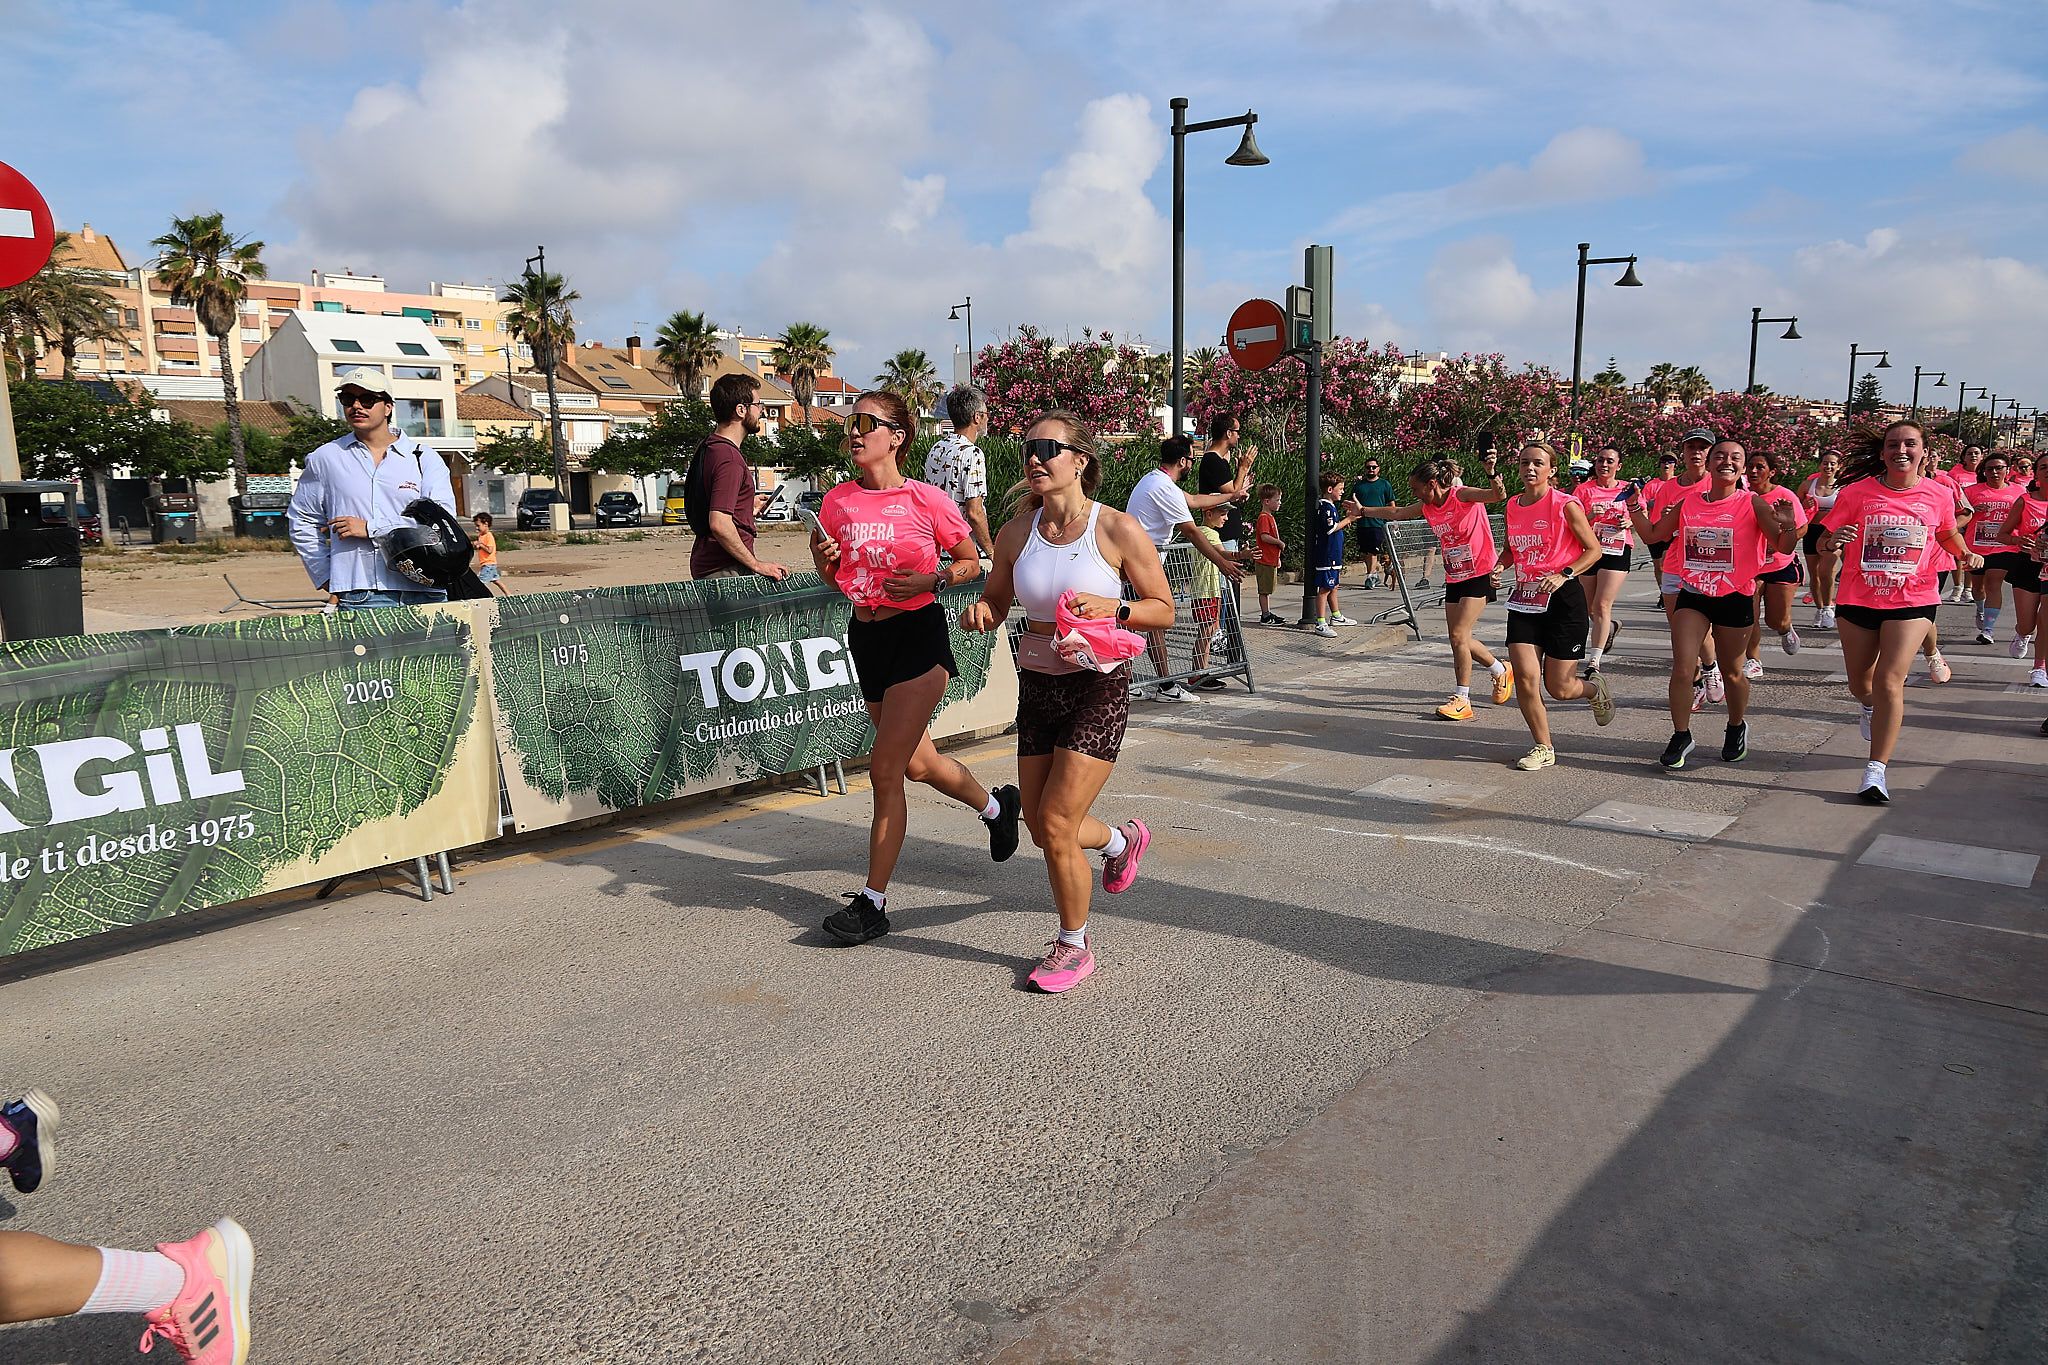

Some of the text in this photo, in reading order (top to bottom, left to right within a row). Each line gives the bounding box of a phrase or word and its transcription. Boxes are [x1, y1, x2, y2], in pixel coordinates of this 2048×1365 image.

[1697, 546, 1716, 555] 016
[1883, 546, 1907, 555] 016
[945, 607, 957, 622] 26
[551, 644, 589, 667] 1975
[680, 634, 859, 709] TONG
[343, 679, 394, 705] 2026
[695, 694, 866, 742] Cuidando de ti desde
[40, 842, 68, 874] ti
[76, 823, 177, 867] desde
[185, 811, 255, 847] 1975
